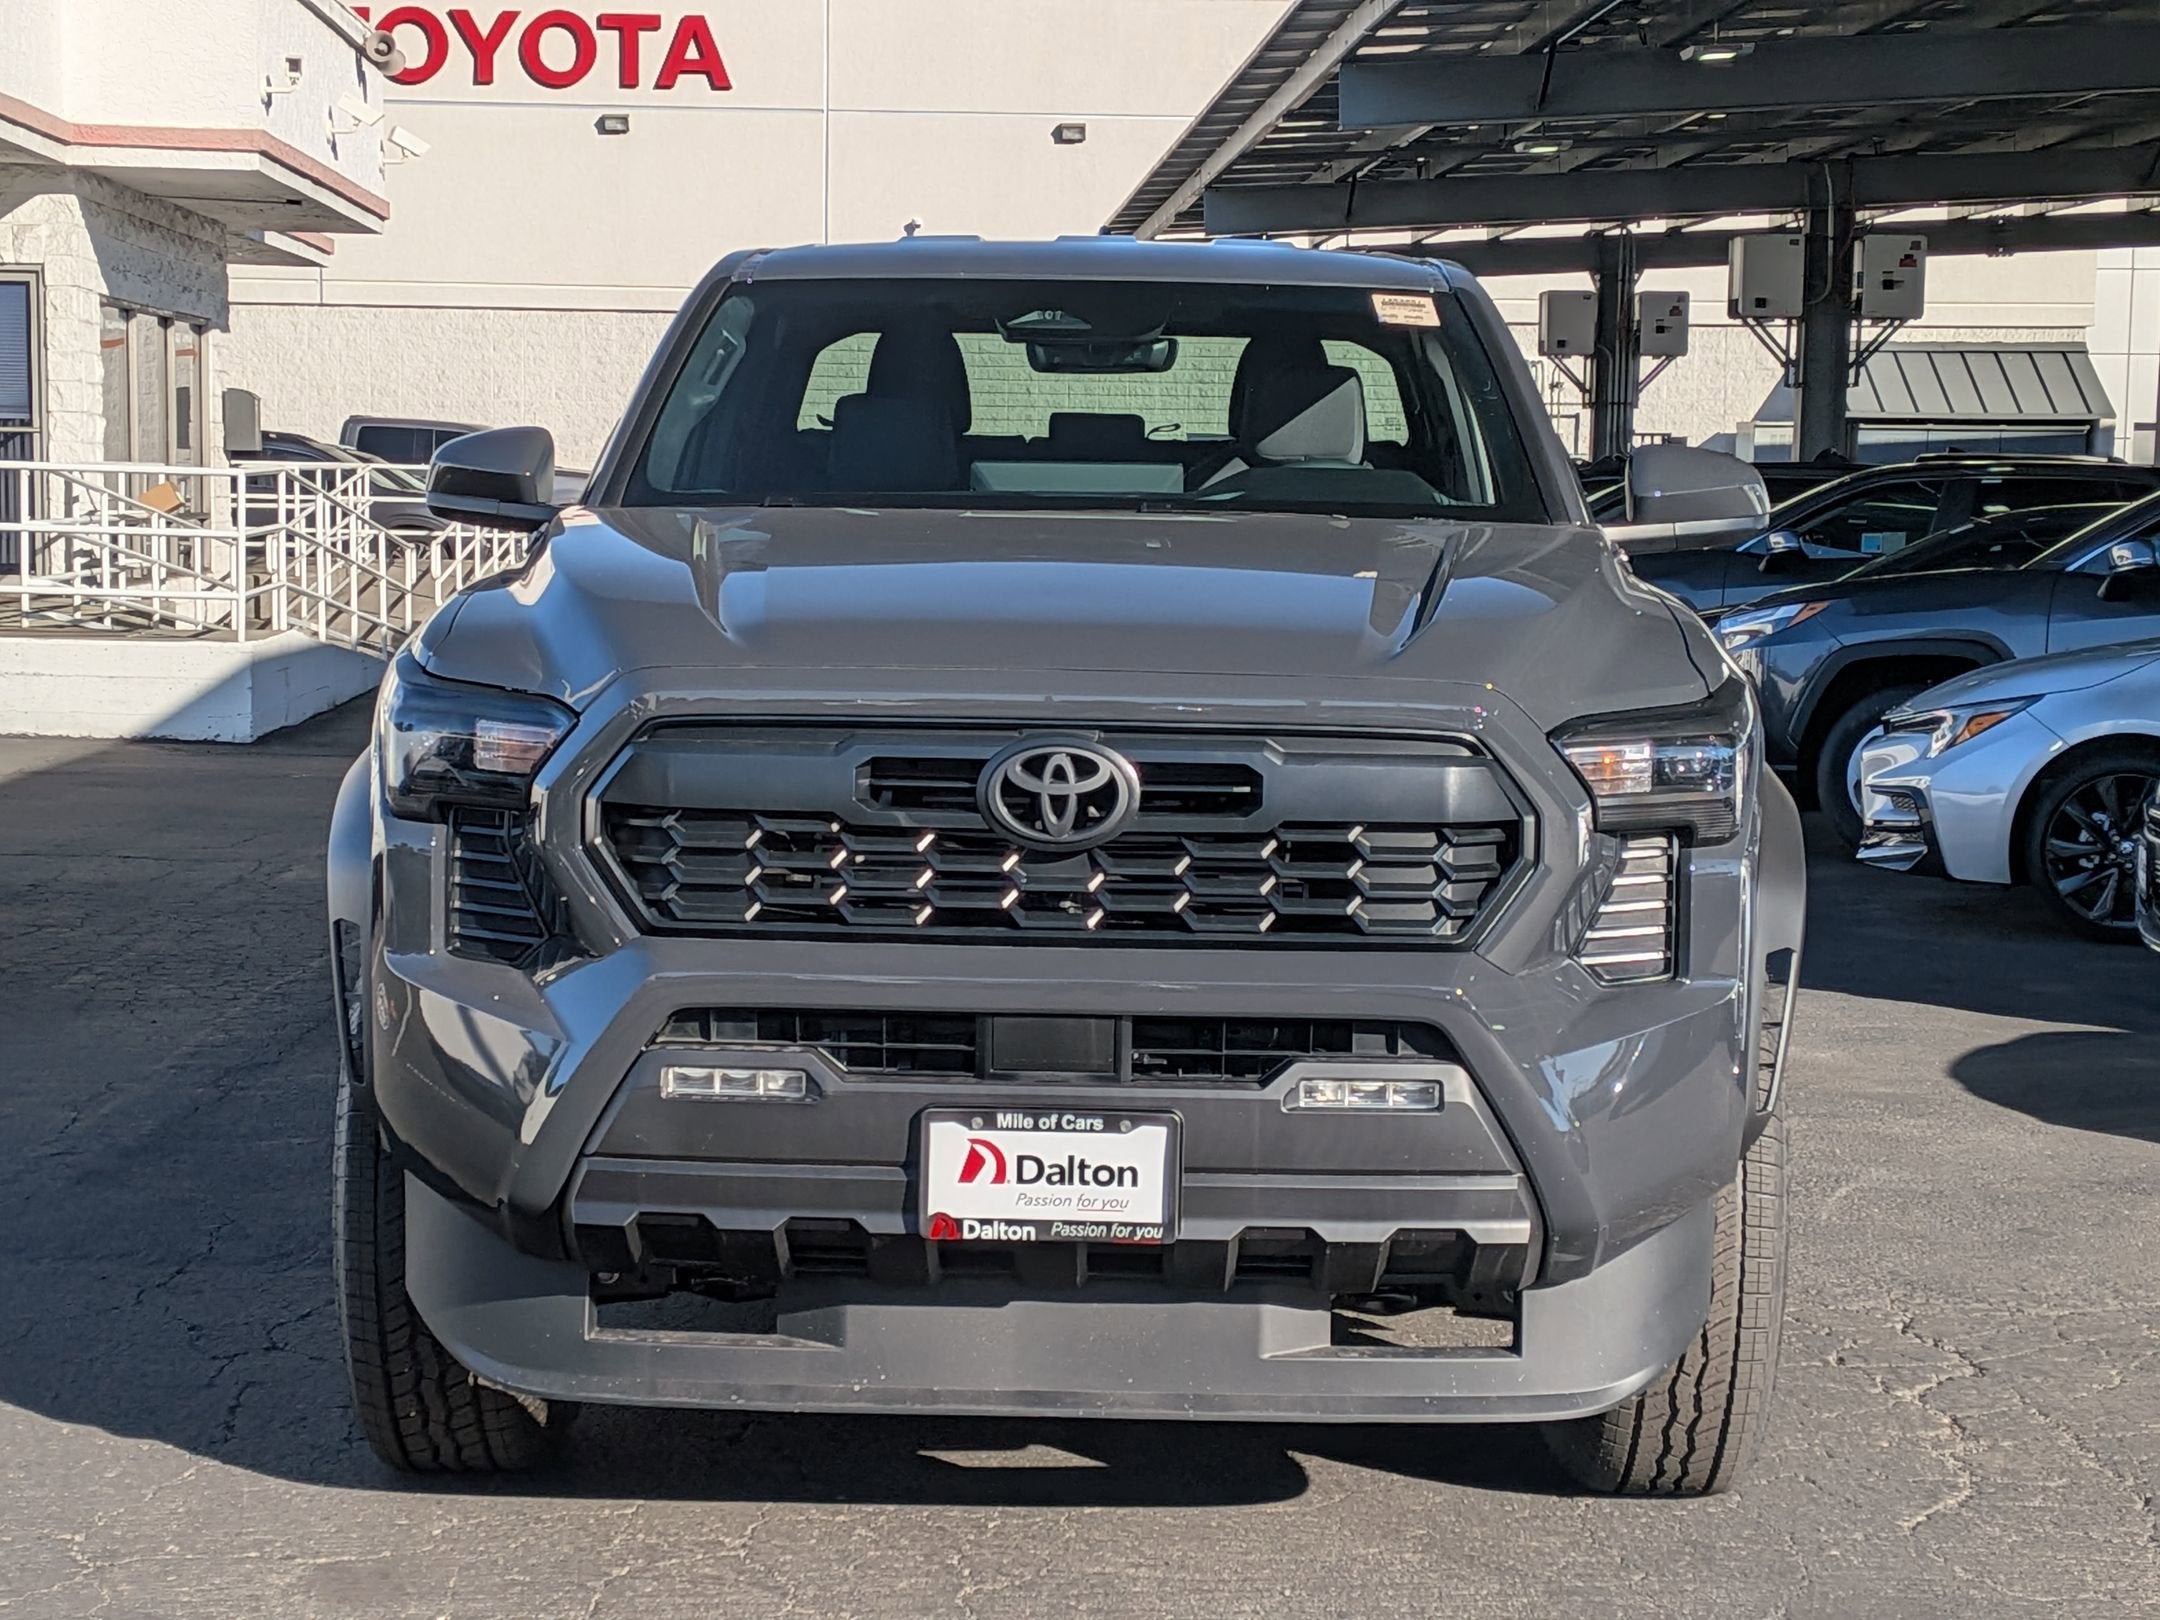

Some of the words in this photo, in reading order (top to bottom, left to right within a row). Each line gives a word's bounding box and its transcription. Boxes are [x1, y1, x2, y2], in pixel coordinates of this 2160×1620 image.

[350, 6, 731, 91] OYOTA
[997, 1113, 1033, 1129] Mile
[1038, 1114, 1058, 1130] of
[1061, 1115, 1104, 1131] Cars
[1016, 1155, 1138, 1188] Dalton
[1015, 1193, 1072, 1207] Passion
[1077, 1193, 1098, 1208] for
[1101, 1199, 1129, 1210] you
[963, 1220, 1036, 1241] Dalton
[1051, 1222, 1106, 1238] Passion
[1110, 1223, 1131, 1238] for
[1134, 1226, 1164, 1241] you
